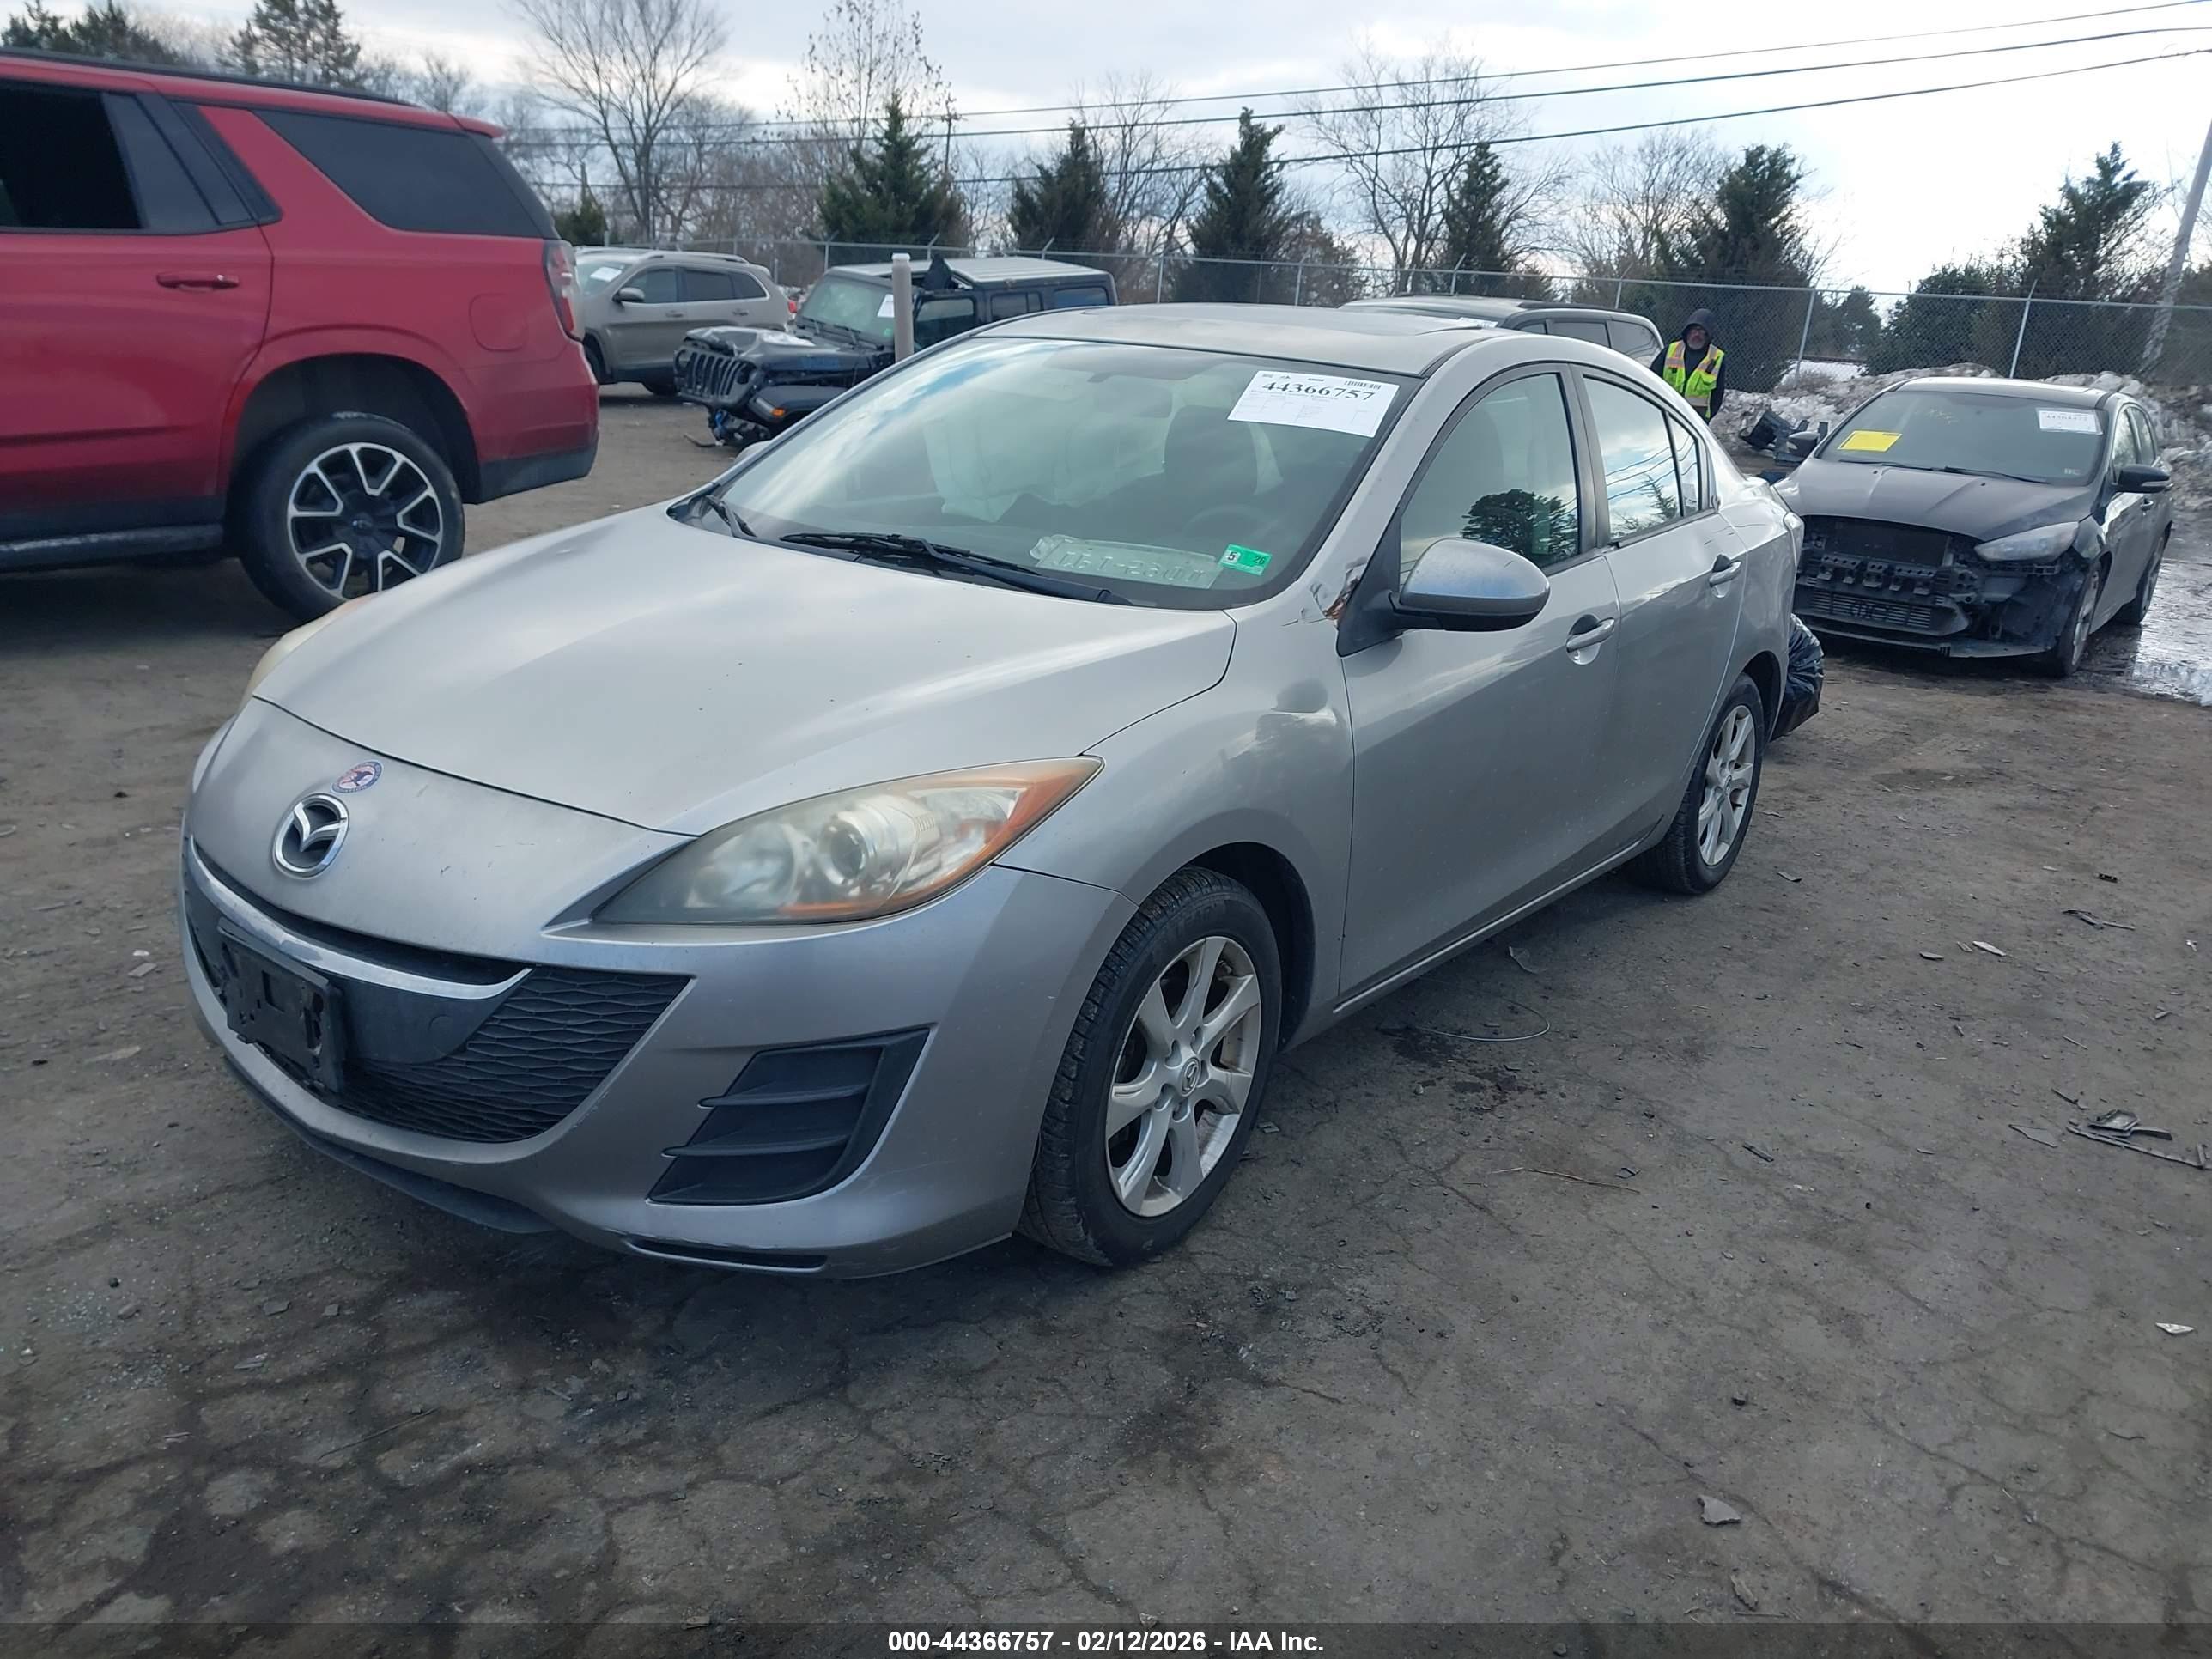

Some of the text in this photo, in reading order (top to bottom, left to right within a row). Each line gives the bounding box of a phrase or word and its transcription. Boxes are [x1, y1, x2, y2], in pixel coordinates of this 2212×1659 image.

[1262, 381, 1375, 401] 44366757
[1227, 551, 1266, 565] 5 26
